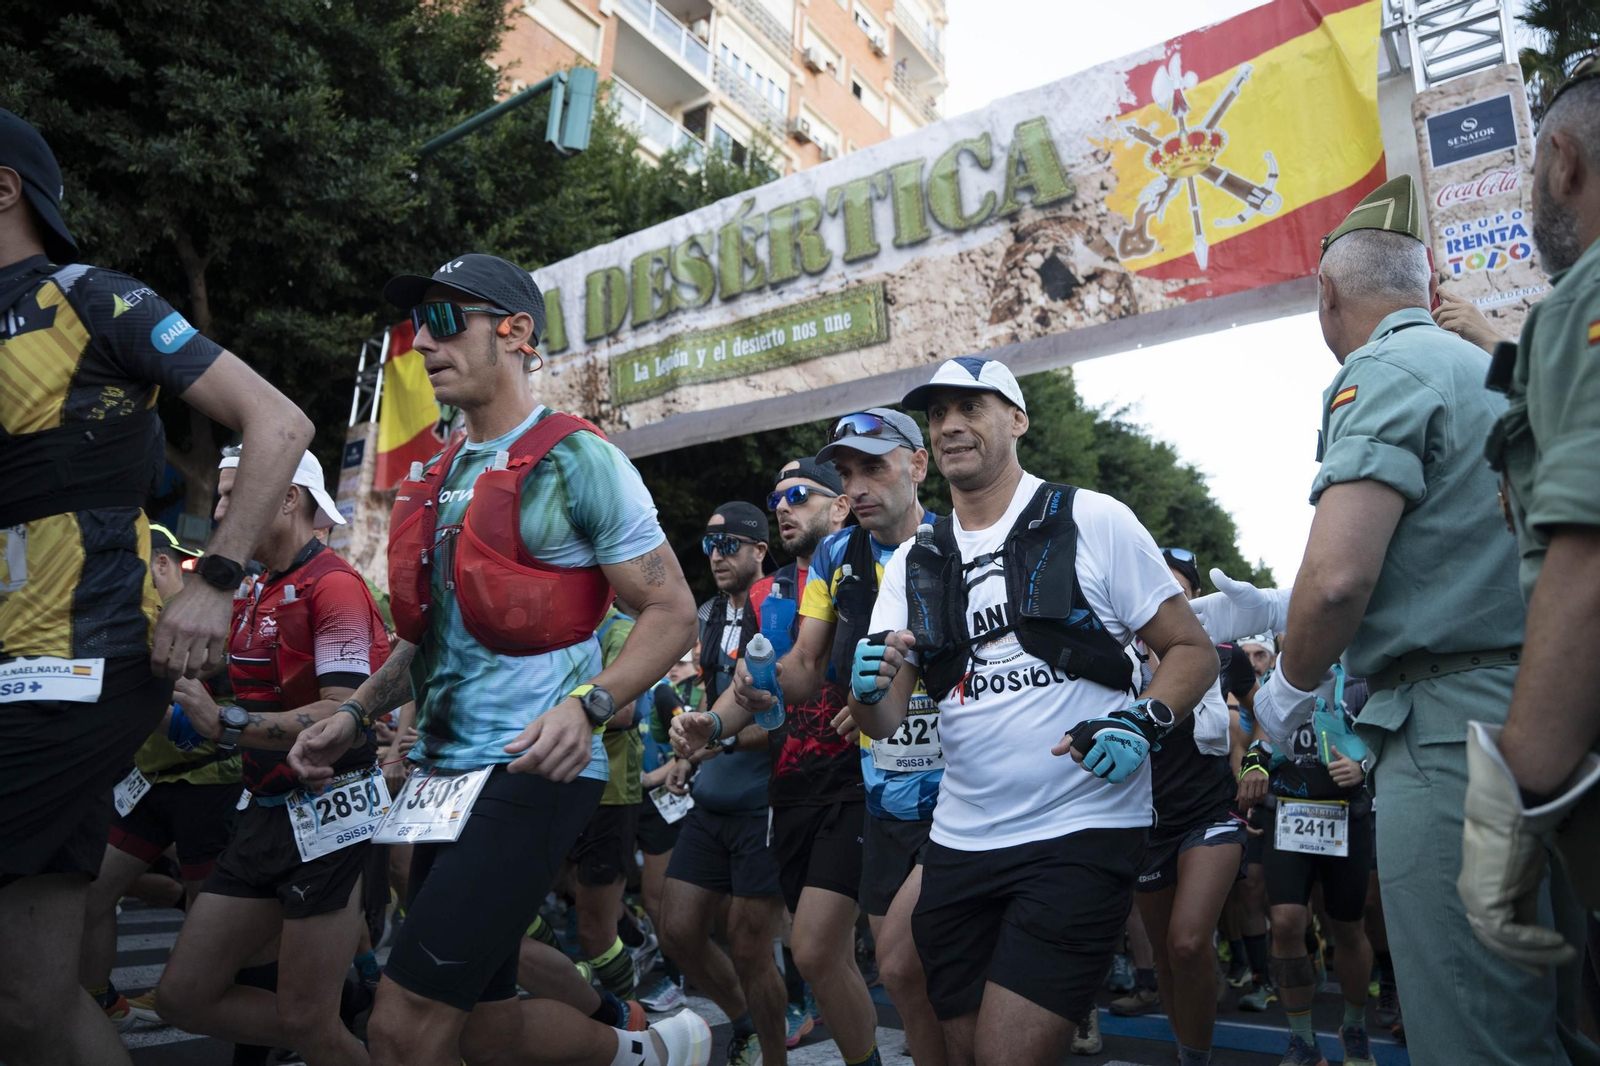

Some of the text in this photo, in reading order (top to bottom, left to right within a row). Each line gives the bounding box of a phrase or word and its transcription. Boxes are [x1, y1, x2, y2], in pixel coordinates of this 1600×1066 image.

[1447, 126, 1496, 148] SENATOR
[540, 114, 1077, 356] A DESÉRTICA
[1444, 210, 1523, 237] GRUPO
[1446, 223, 1529, 255] RENTA
[1447, 242, 1531, 275] TODO
[633, 311, 852, 383] La Legión y el desierto nos une
[1001, 651, 1024, 665] WALKING
[887, 716, 941, 746] 321
[896, 758, 925, 768] asisa
[315, 781, 381, 827] 2850
[335, 826, 368, 845] asisa
[1293, 818, 1336, 839] 2411
[1299, 843, 1320, 852] asisa
[1138, 870, 1162, 884] ERREX
